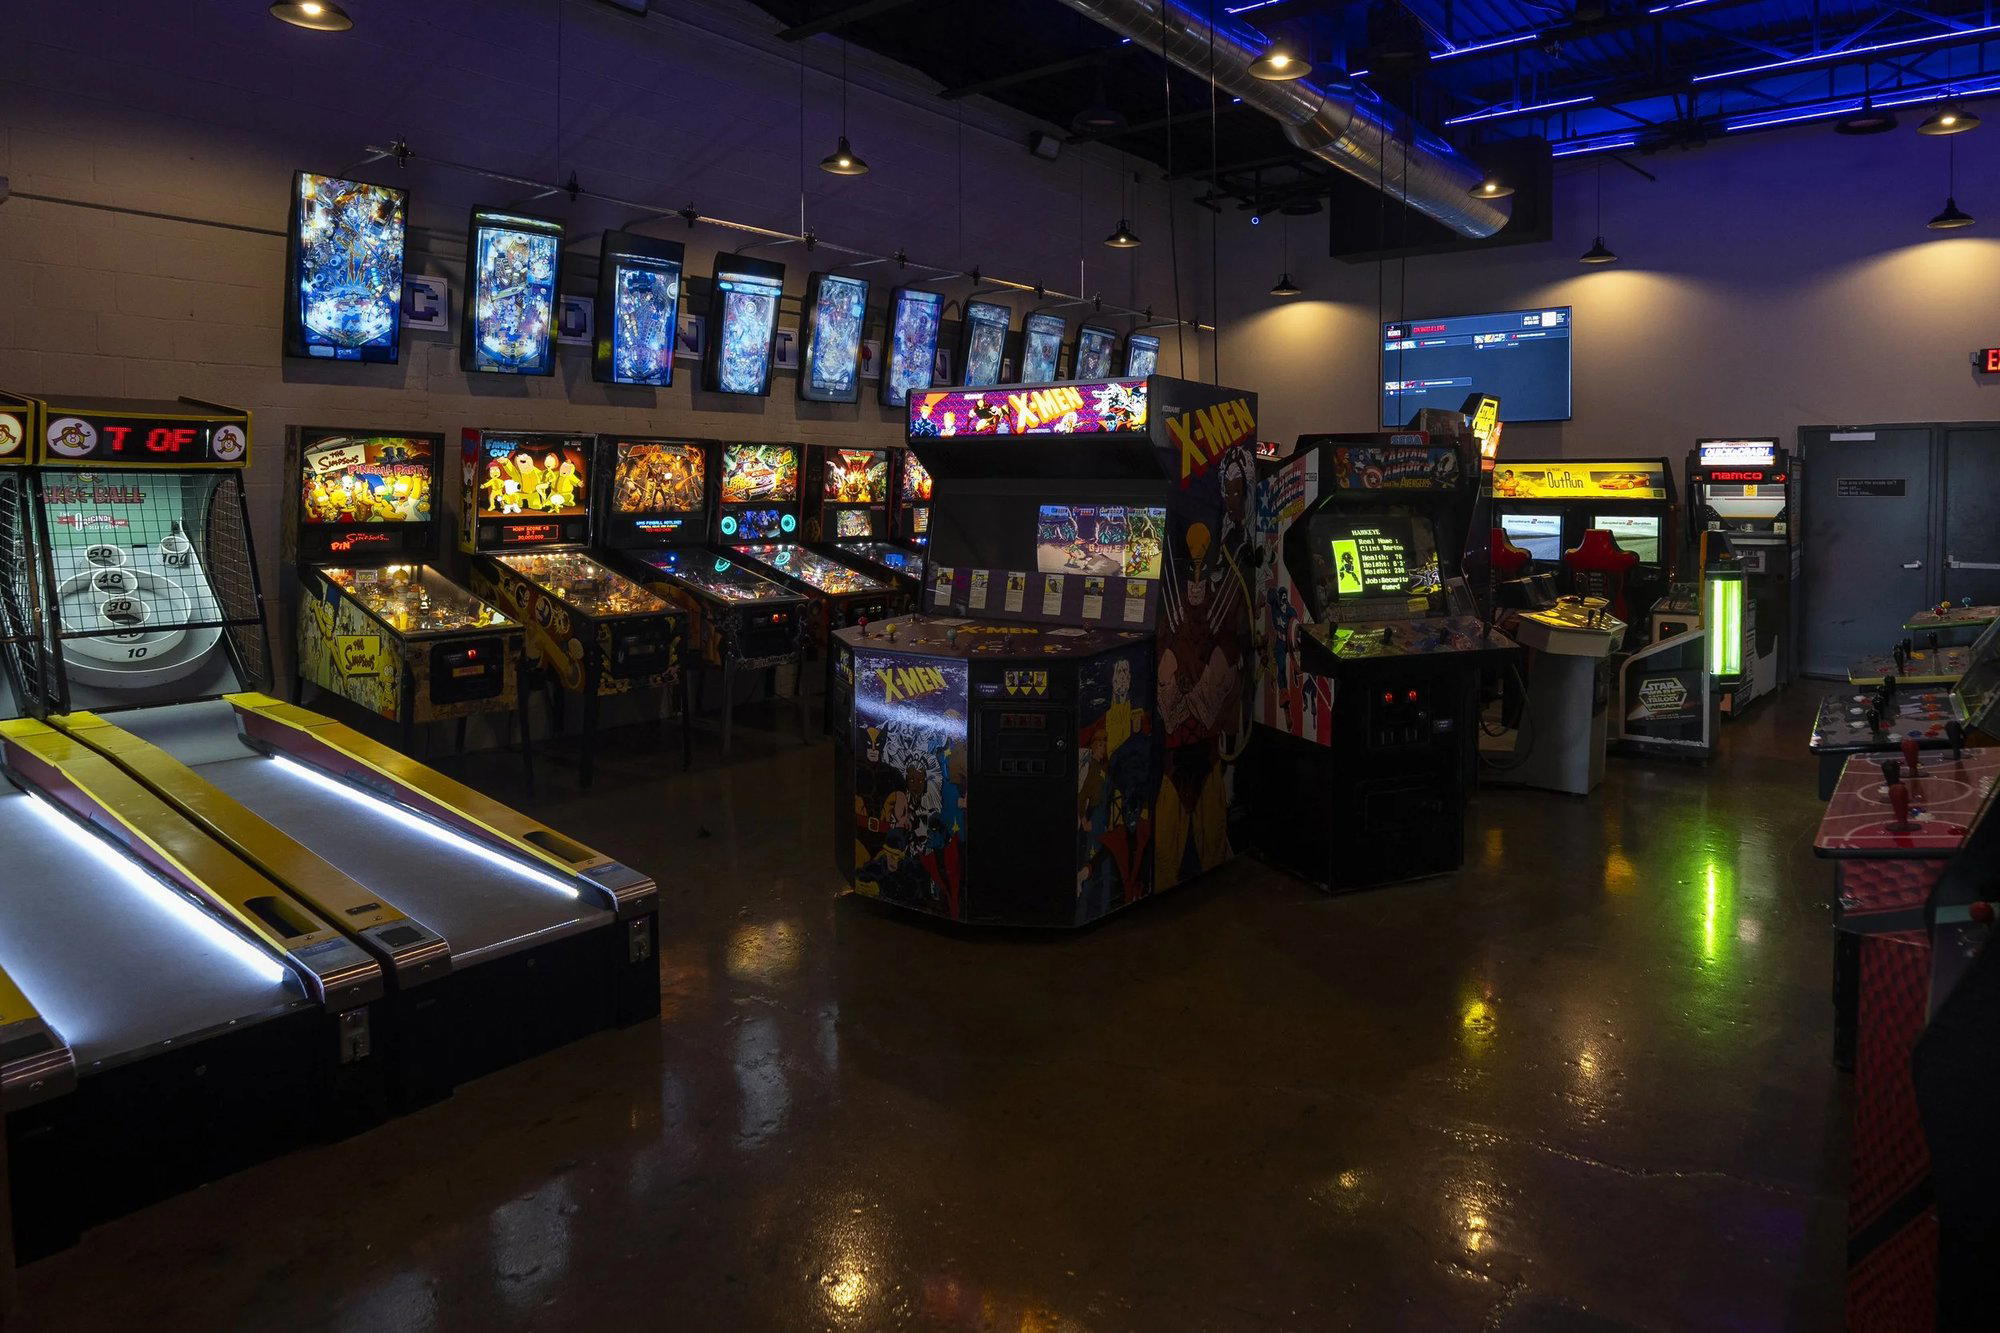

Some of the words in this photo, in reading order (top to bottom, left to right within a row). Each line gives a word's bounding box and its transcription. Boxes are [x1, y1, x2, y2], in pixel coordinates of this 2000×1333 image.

[1988, 350, 2000, 370] E
[1008, 387, 1084, 434] X-MEN
[145, 428, 198, 452] OF
[485, 439, 518, 450] FAMILY
[1165, 398, 1256, 480] X-MEN
[1391, 435, 1423, 445] SEGA
[329, 449, 345, 458] THE
[489, 449, 509, 458] GUY
[347, 464, 391, 476] PINBALL
[393, 464, 428, 478] PARTY
[1711, 472, 1762, 480] namco
[1546, 471, 1584, 488] OutRun
[93, 485, 144, 504] BALL
[331, 541, 351, 551] PIN
[89, 548, 113, 559] 50
[98, 573, 123, 584] 40
[107, 600, 132, 612] 30
[957, 625, 1040, 635] X-MEN
[127, 647, 148, 658] 10
[875, 666, 948, 704] X-MEN
[1647, 682, 1675, 691] STAR
